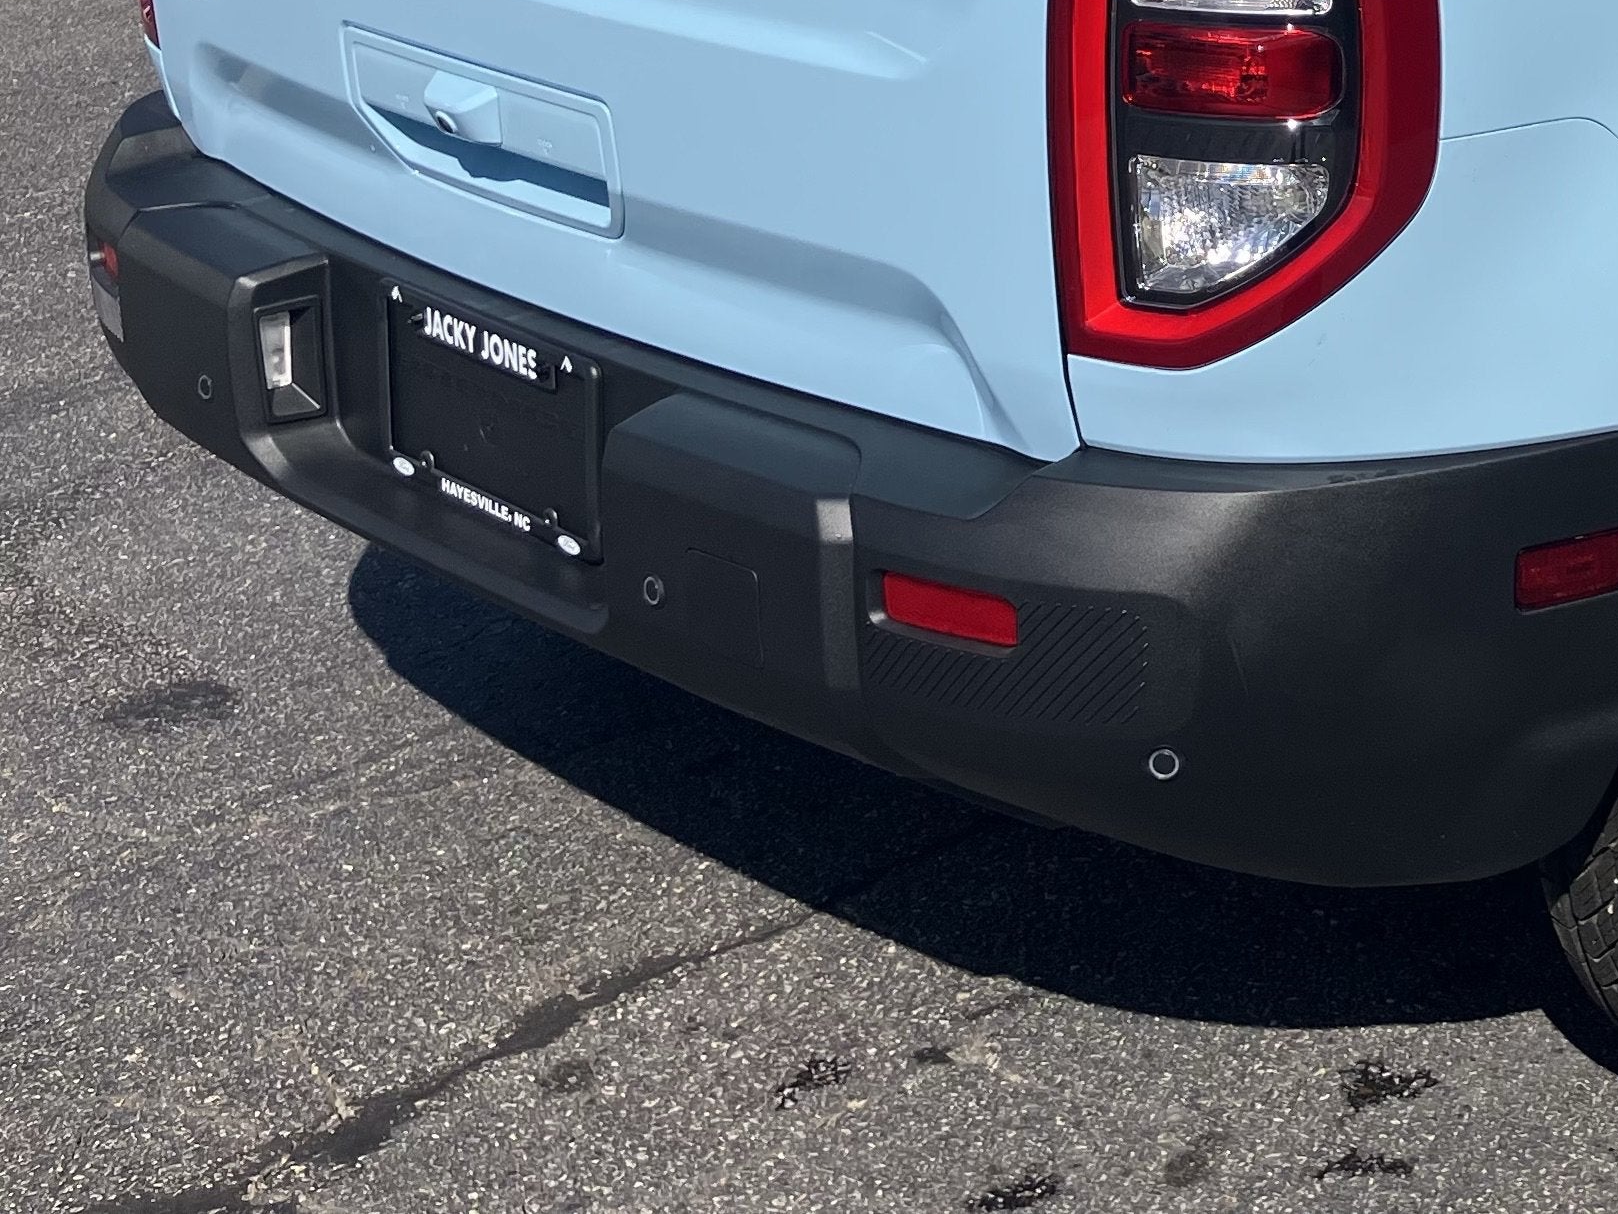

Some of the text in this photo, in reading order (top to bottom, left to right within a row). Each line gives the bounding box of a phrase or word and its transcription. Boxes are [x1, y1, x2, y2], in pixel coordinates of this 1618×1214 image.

[424, 306, 538, 380] JACKY JONES
[441, 477, 531, 532] HAYESVILLE, NC
